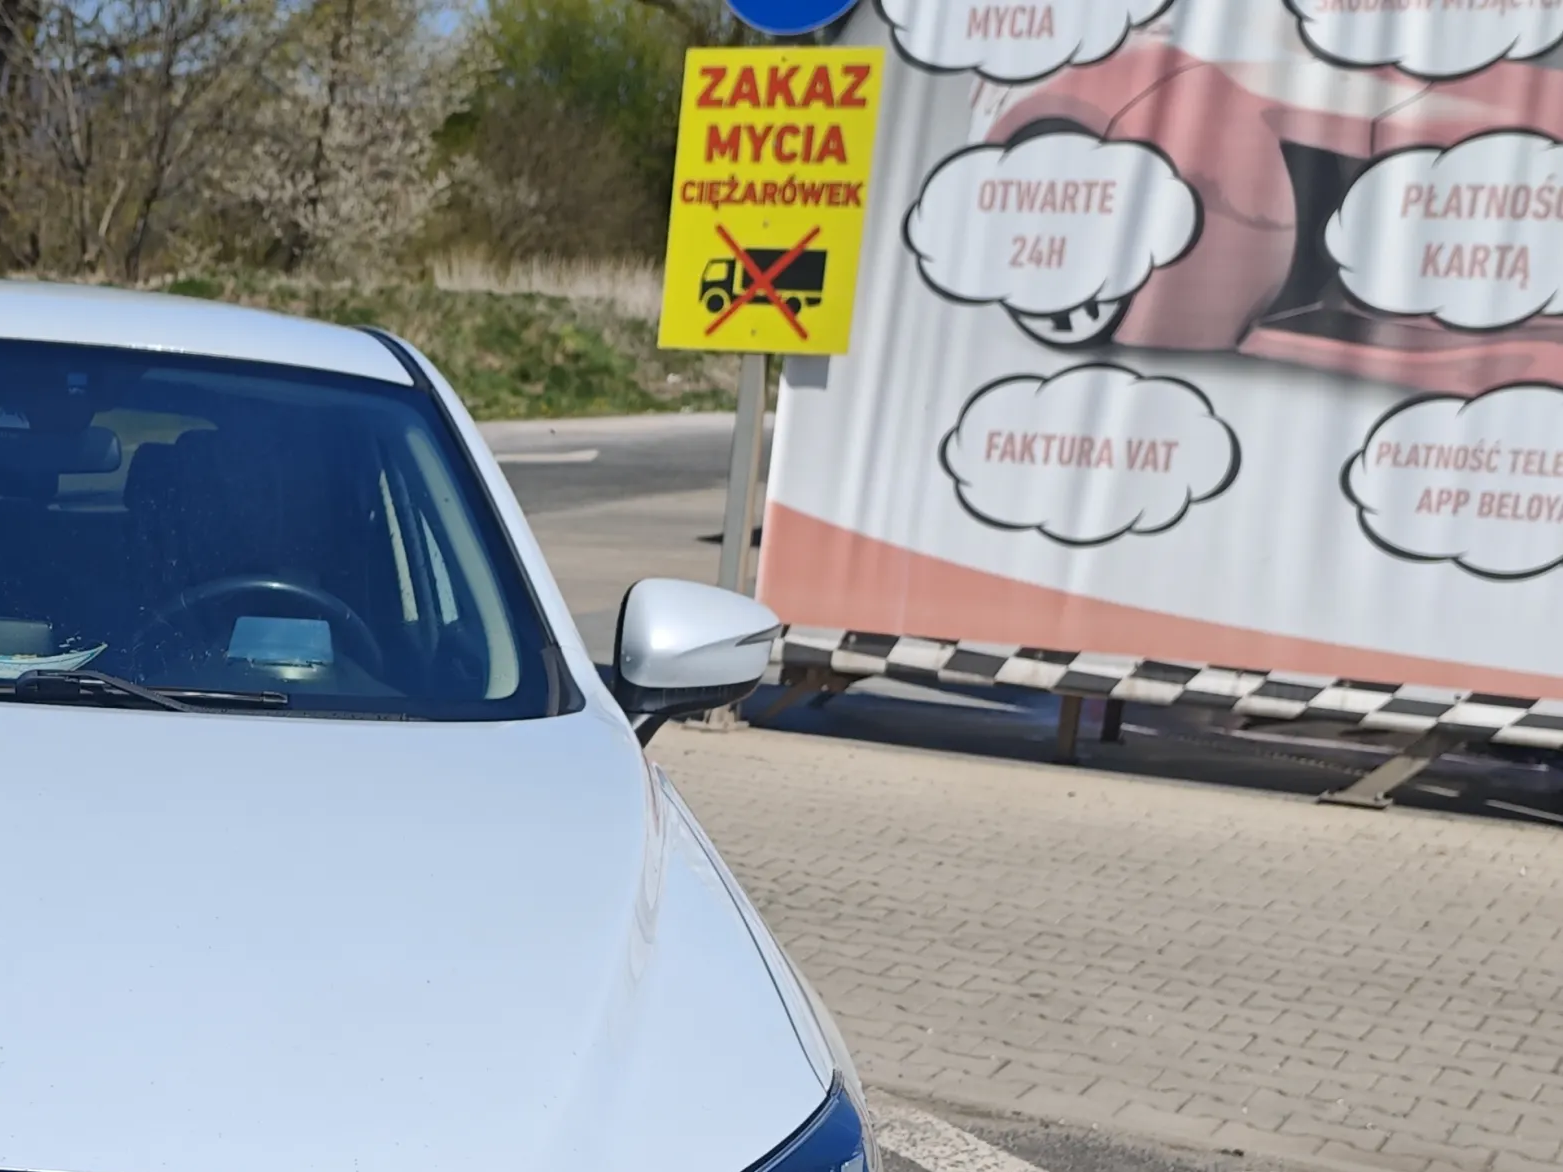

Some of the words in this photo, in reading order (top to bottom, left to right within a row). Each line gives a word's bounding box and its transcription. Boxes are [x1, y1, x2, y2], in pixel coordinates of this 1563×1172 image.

[965, 5, 1055, 39] MYCIA
[696, 65, 871, 109] ZAKAZ
[704, 122, 848, 165] MYCIA
[679, 172, 864, 211] CIĘŻARÓWEK
[977, 179, 1117, 214] OTWARTE
[1009, 235, 1067, 269] 24H
[1419, 241, 1531, 290] KARTĄ
[984, 428, 1114, 468] FAKTURA
[1126, 437, 1180, 473] VAT
[1376, 438, 1506, 474] PŁATNOŚĆ
[1414, 486, 1472, 517] APP
